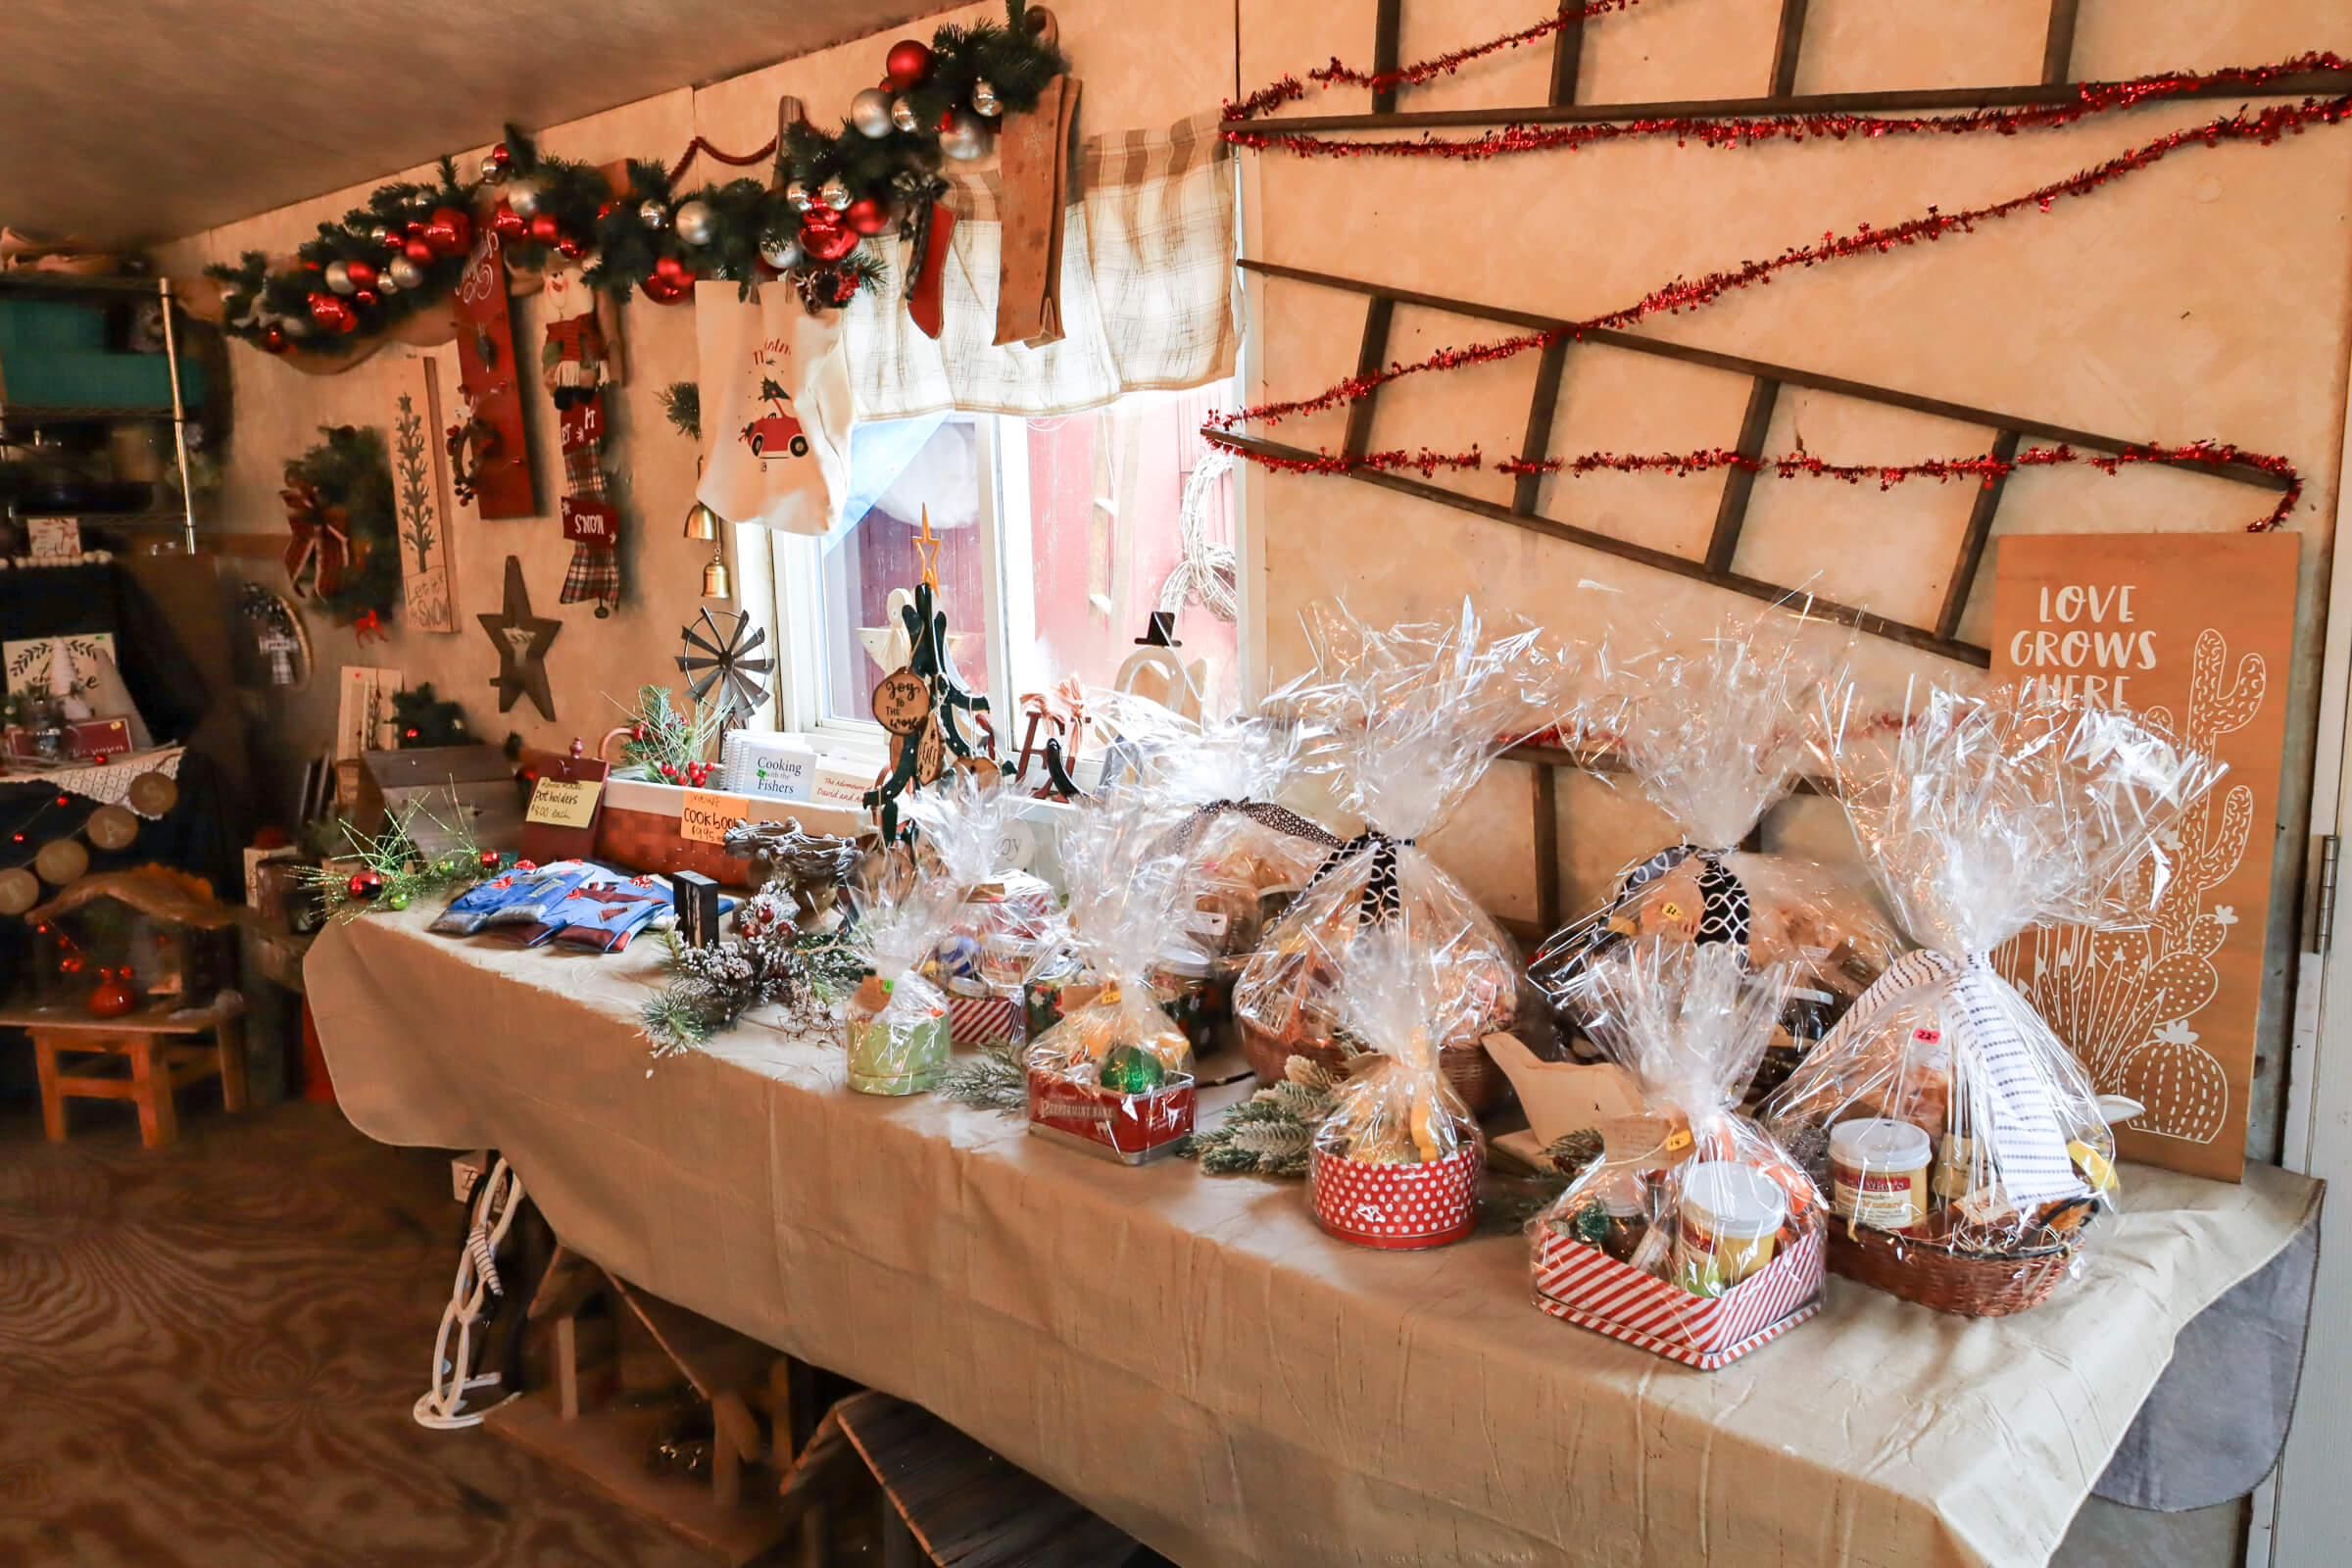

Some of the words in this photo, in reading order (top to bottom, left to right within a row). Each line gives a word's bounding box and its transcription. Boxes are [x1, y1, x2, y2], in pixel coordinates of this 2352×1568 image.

[574, 514, 605, 535] SNOW
[2039, 585, 2136, 623] LOVE
[2010, 630, 2157, 670] GROWS
[885, 681, 921, 702] Joy
[886, 706, 901, 716] THE
[758, 756, 802, 777] Cooking
[758, 779, 794, 795] Fishers
[817, 787, 839, 799] David
[839, 792, 855, 801] and
[550, 792, 578, 805] holders
